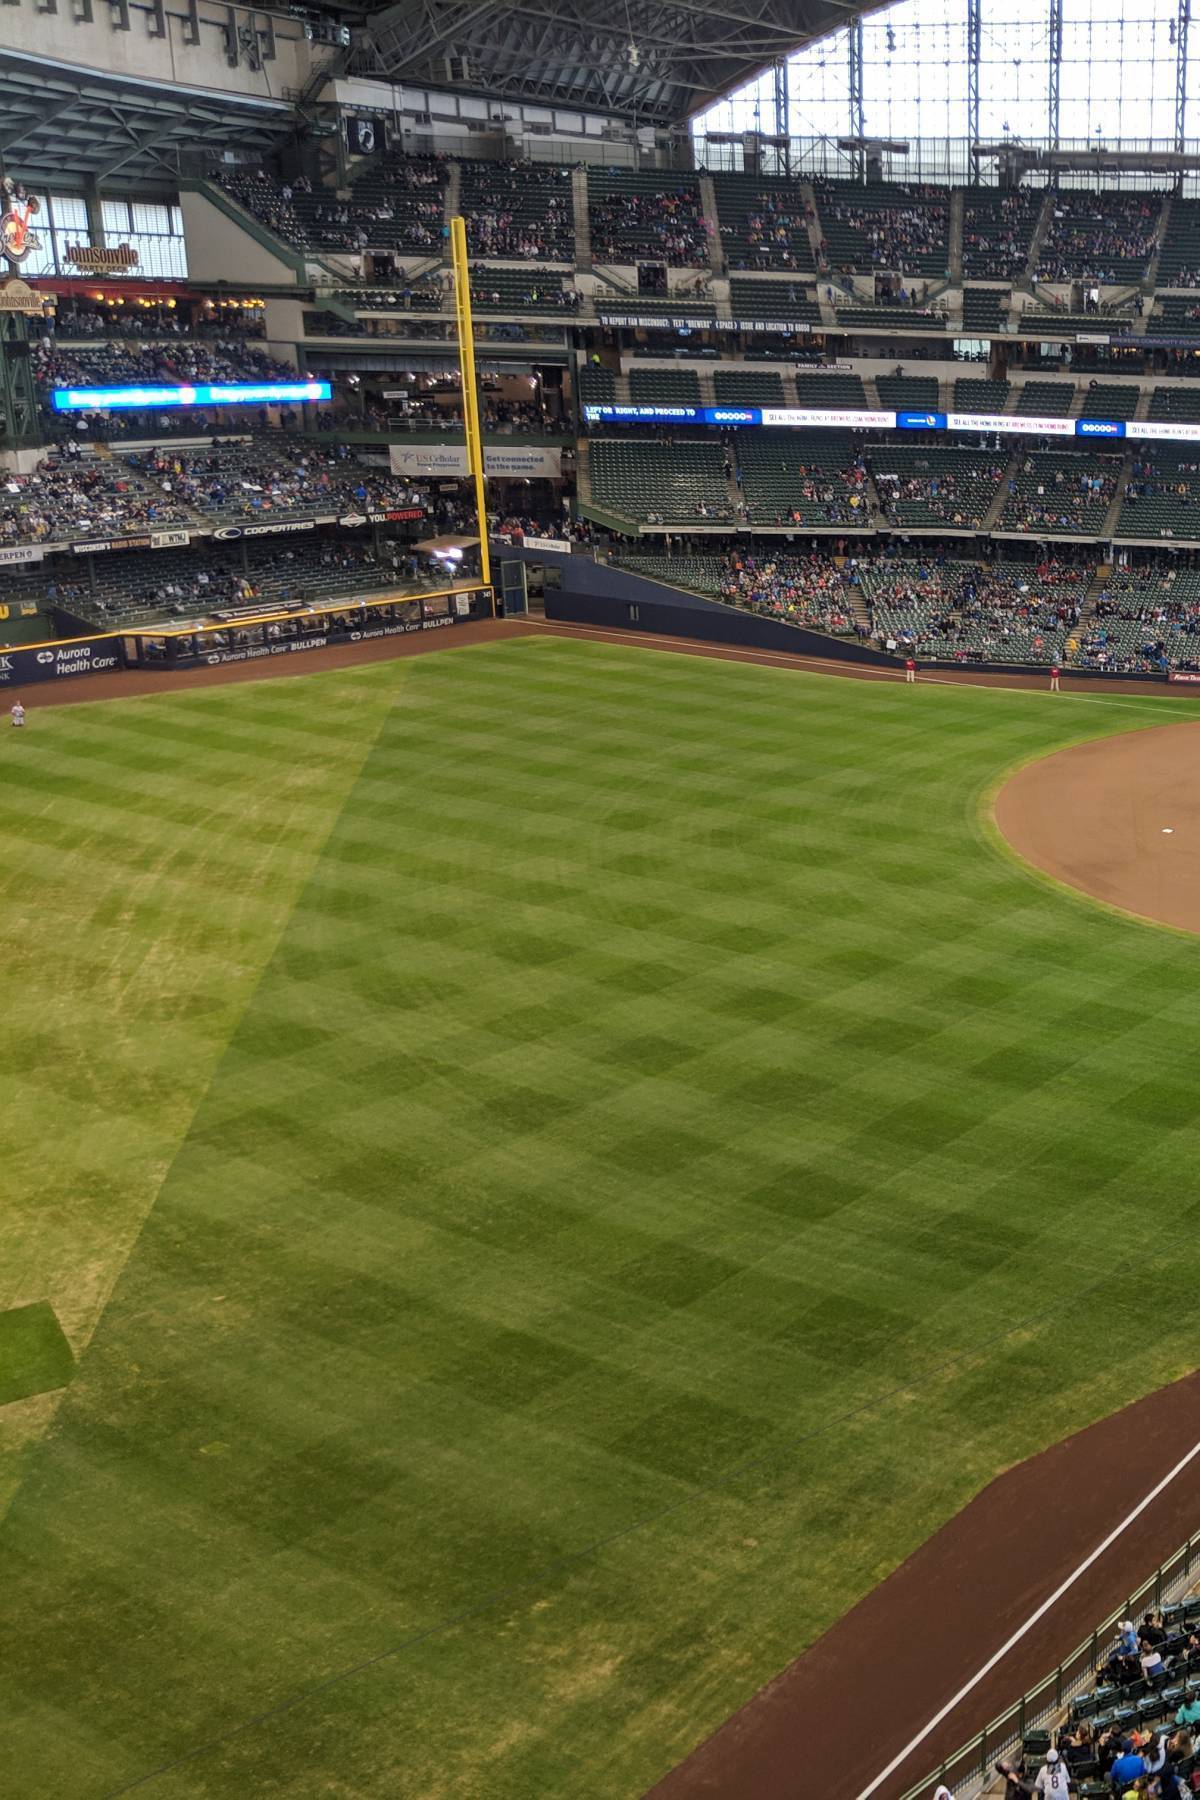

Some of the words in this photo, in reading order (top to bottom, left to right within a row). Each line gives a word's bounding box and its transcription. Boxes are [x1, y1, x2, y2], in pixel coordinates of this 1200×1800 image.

[63, 240, 139, 265] Johnsonville
[78, 264, 105, 272] PARTY
[107, 265, 128, 273] DECK
[615, 407, 638, 416] RIGHT,
[655, 408, 685, 416] PROCEED
[74, 542, 111, 553] WISCONSIN'S
[111, 540, 128, 550] RADIO
[129, 538, 150, 548] STATION
[362, 630, 384, 639] Aurora
[384, 625, 404, 635] Health
[405, 623, 419, 632] Care
[422, 617, 454, 629] BULLPEN
[57, 647, 91, 660] Aurora
[221, 652, 246, 662] Aurora
[247, 647, 270, 658] Health
[271, 645, 287, 654] Care
[291, 638, 327, 651] BULLPEN
[56, 660, 90, 675] Health
[92, 657, 115, 669] Care
[1051, 1775, 1059, 1789] 8
